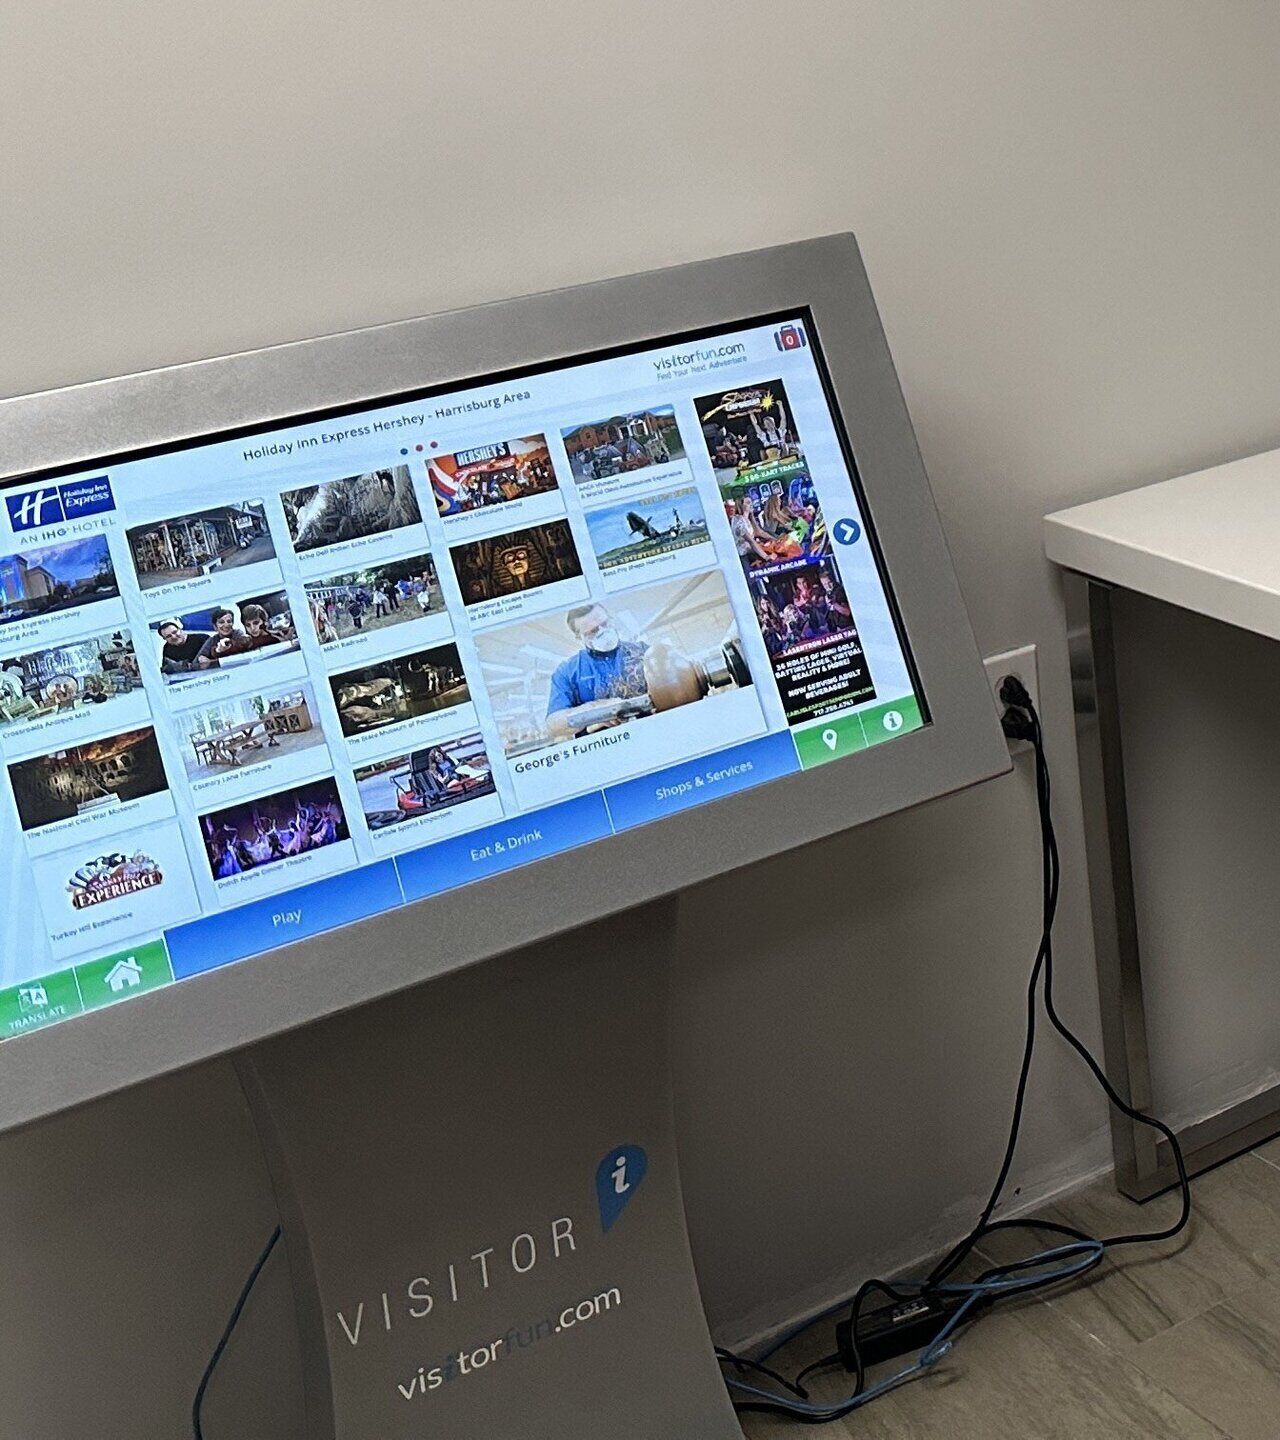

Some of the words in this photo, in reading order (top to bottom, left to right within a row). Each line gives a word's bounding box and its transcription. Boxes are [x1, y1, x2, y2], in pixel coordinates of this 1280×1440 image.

[653, 342, 745, 372] visitorfun.com
[242, 443, 294, 461] Holiday
[296, 438, 318, 449] Inn
[320, 426, 370, 443] Express
[373, 414, 426, 433] Hershey
[434, 397, 501, 419] Harrisburg
[501, 391, 530, 402] Area
[62, 487, 94, 499] Holiday
[93, 483, 108, 492] Inn
[64, 491, 110, 507] Express
[19, 533, 40, 545] AN
[72, 515, 115, 533] HOTEL
[514, 750, 570, 774] George's
[572, 731, 631, 756] Furniture
[654, 781, 691, 800] Shops
[692, 773, 707, 788] &
[708, 761, 753, 783] Services
[470, 844, 493, 862] Eat
[493, 840, 505, 854] &
[506, 827, 542, 849] Drink
[78, 871, 157, 907] EXPERIENCE
[271, 909, 305, 928] Play
[8, 1004, 65, 1032] TRANSLATE
[337, 1217, 576, 1345] VISITOR
